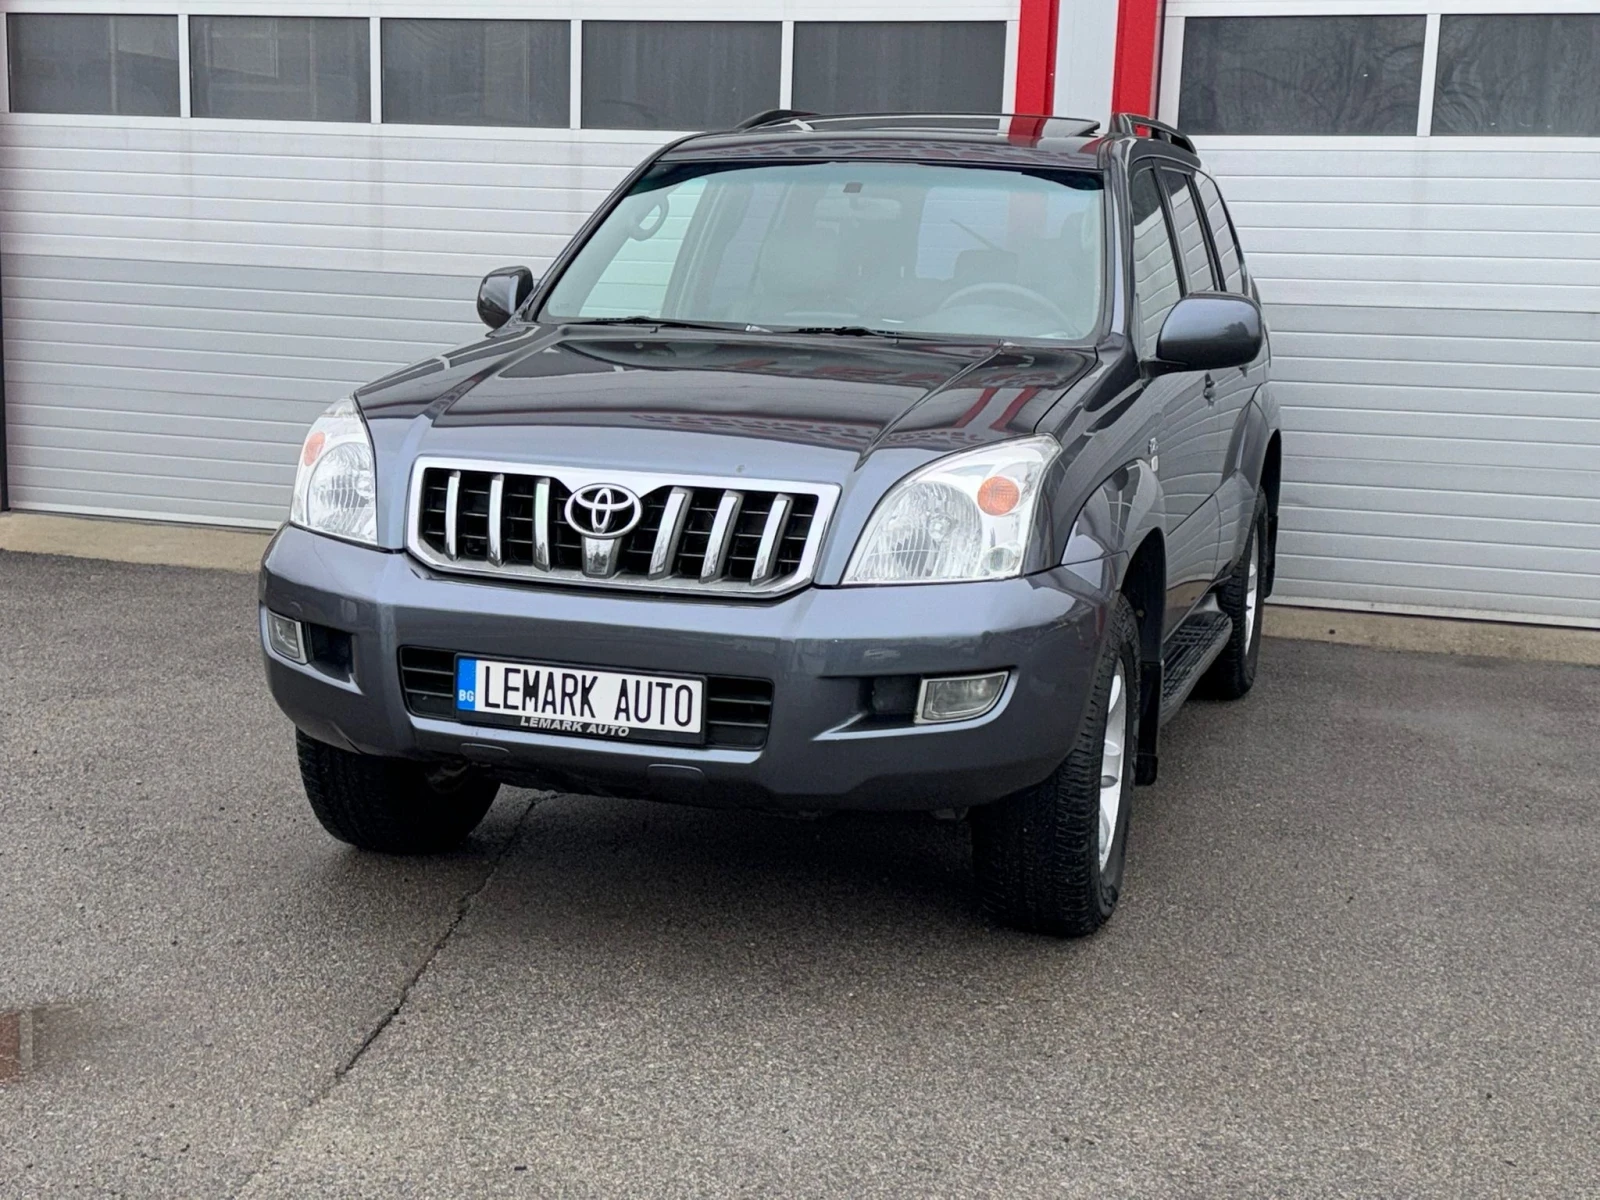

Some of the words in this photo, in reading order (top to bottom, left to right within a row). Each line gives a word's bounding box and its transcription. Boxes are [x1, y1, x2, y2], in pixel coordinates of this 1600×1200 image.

[458, 689, 475, 702] BG
[484, 665, 598, 718] LEMARK
[614, 678, 694, 727] AUTO
[520, 716, 583, 733] LEMARK
[586, 723, 630, 737] AUTO
